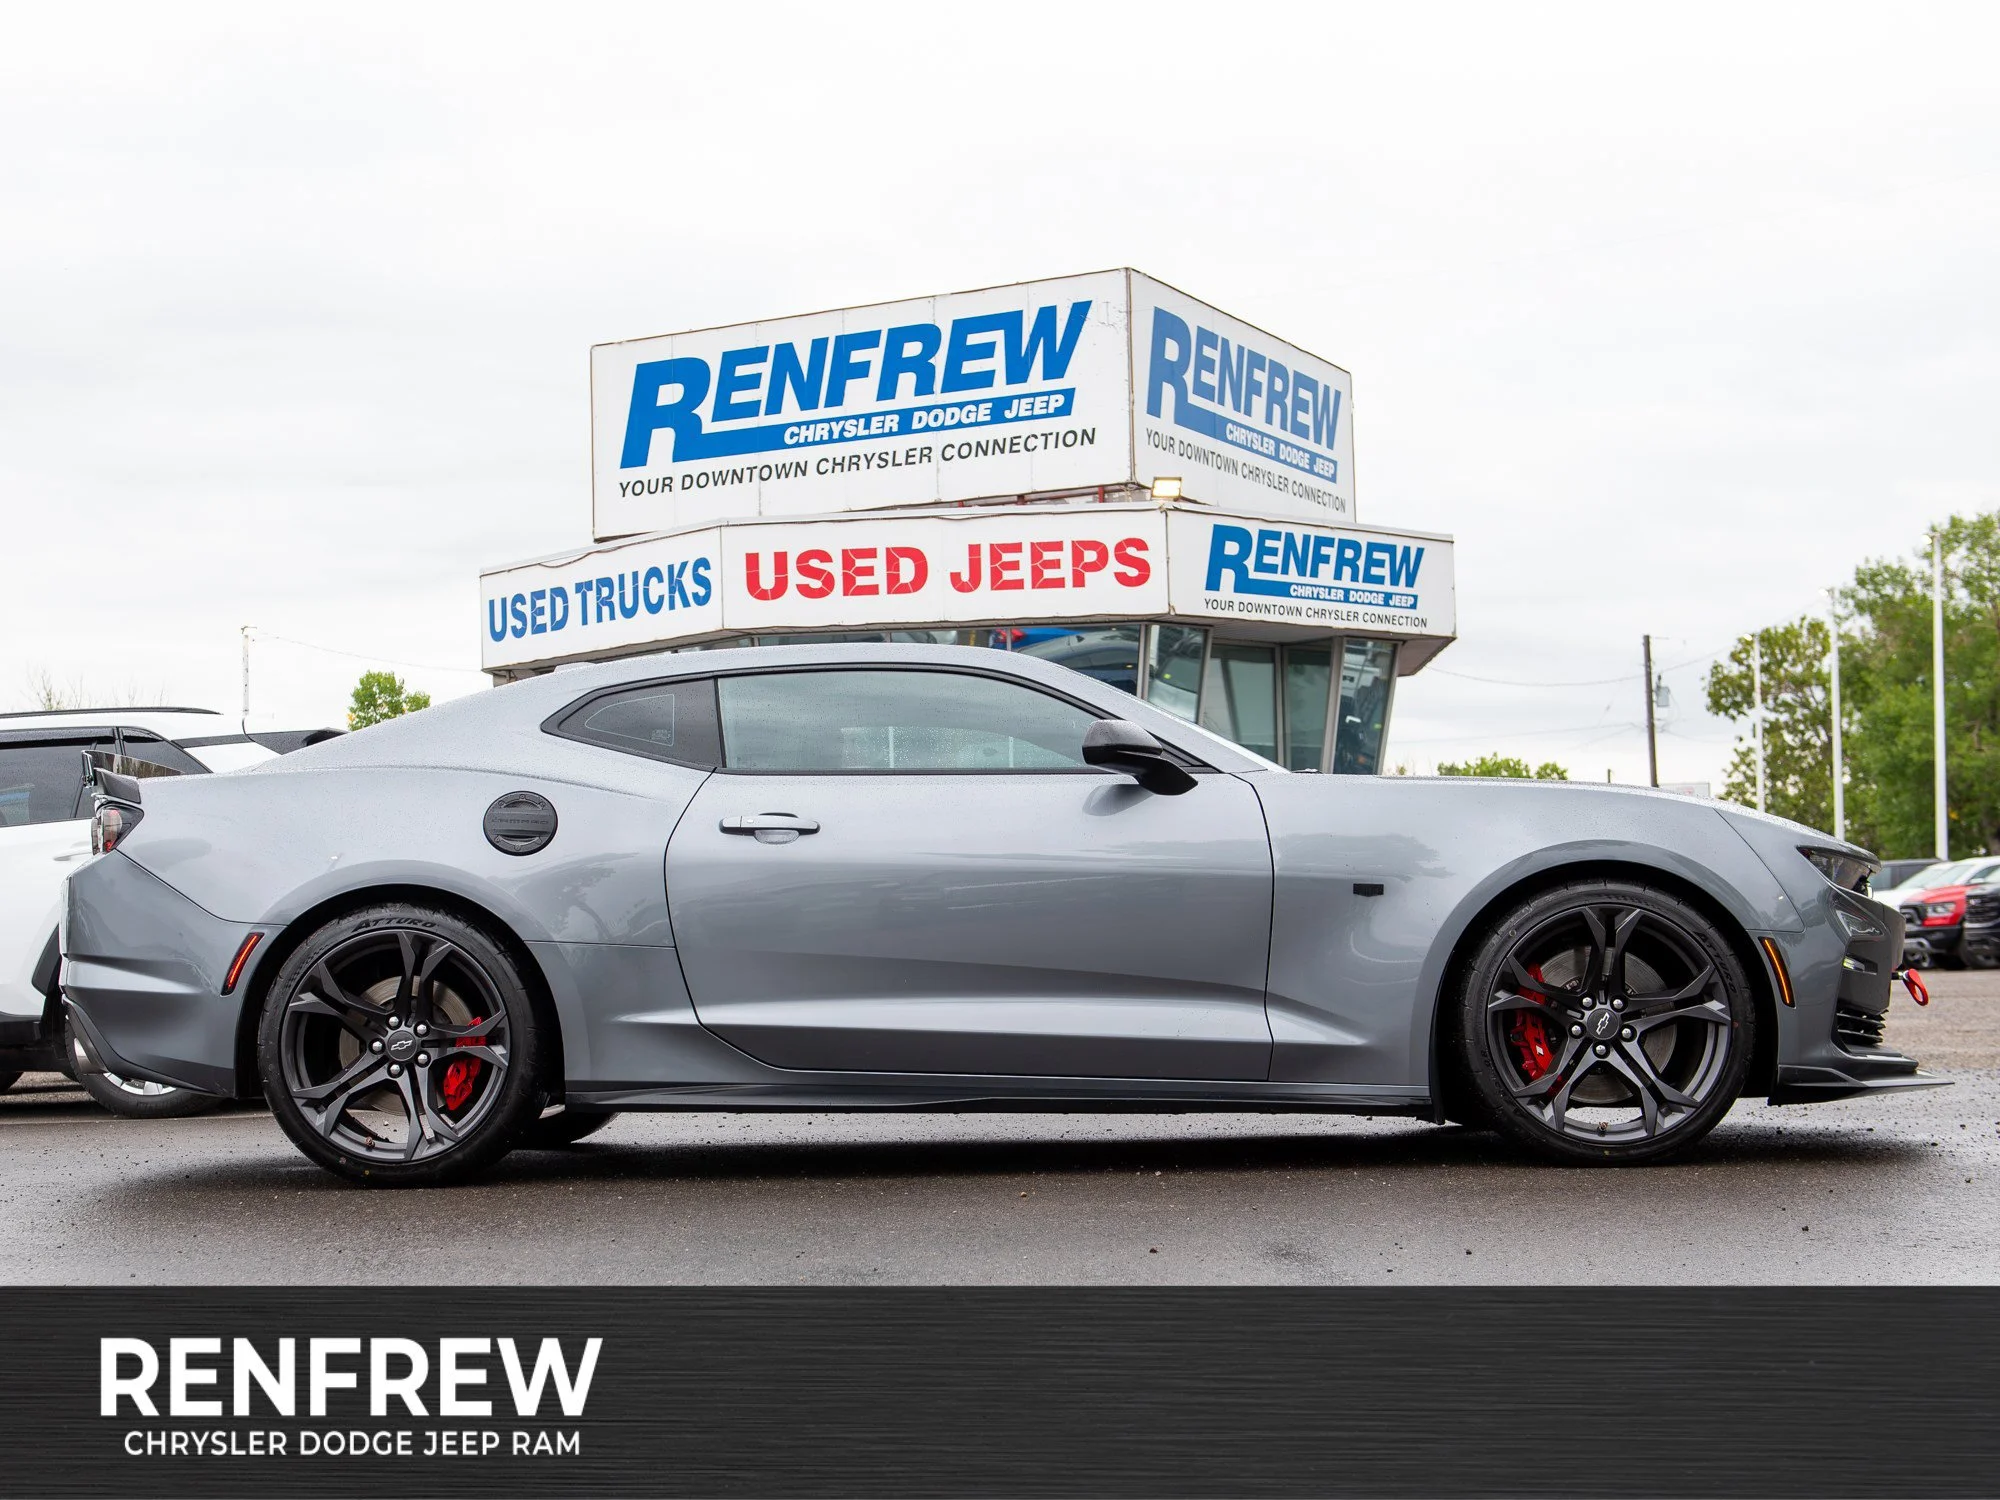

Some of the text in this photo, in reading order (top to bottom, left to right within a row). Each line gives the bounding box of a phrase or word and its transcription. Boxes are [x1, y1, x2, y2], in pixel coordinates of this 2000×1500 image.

[620, 300, 1092, 468] RENFREW
[1147, 306, 1341, 450] RENFREW
[783, 394, 1065, 445] CHRYSLER DODGE JEEP
[1226, 423, 1335, 478] CHRYSLER DODGE JEEP
[619, 427, 1096, 498] YOUR DOWNTOWN CHRYSLER CONNECTION
[1146, 428, 1346, 513] YOUR DOWNTOWN CHRYSLER CONNECTION
[745, 537, 1150, 600] USED JEEPS
[1205, 524, 1425, 592] RENFREW
[489, 557, 712, 642] USED TRUCKS
[1204, 599, 1428, 628] YOUR DOWNTOWN CHRYSLER CONNECTION
[1290, 584, 1415, 607] CHRYSLER DODGE JEEP
[351, 917, 437, 933] ATTURO
